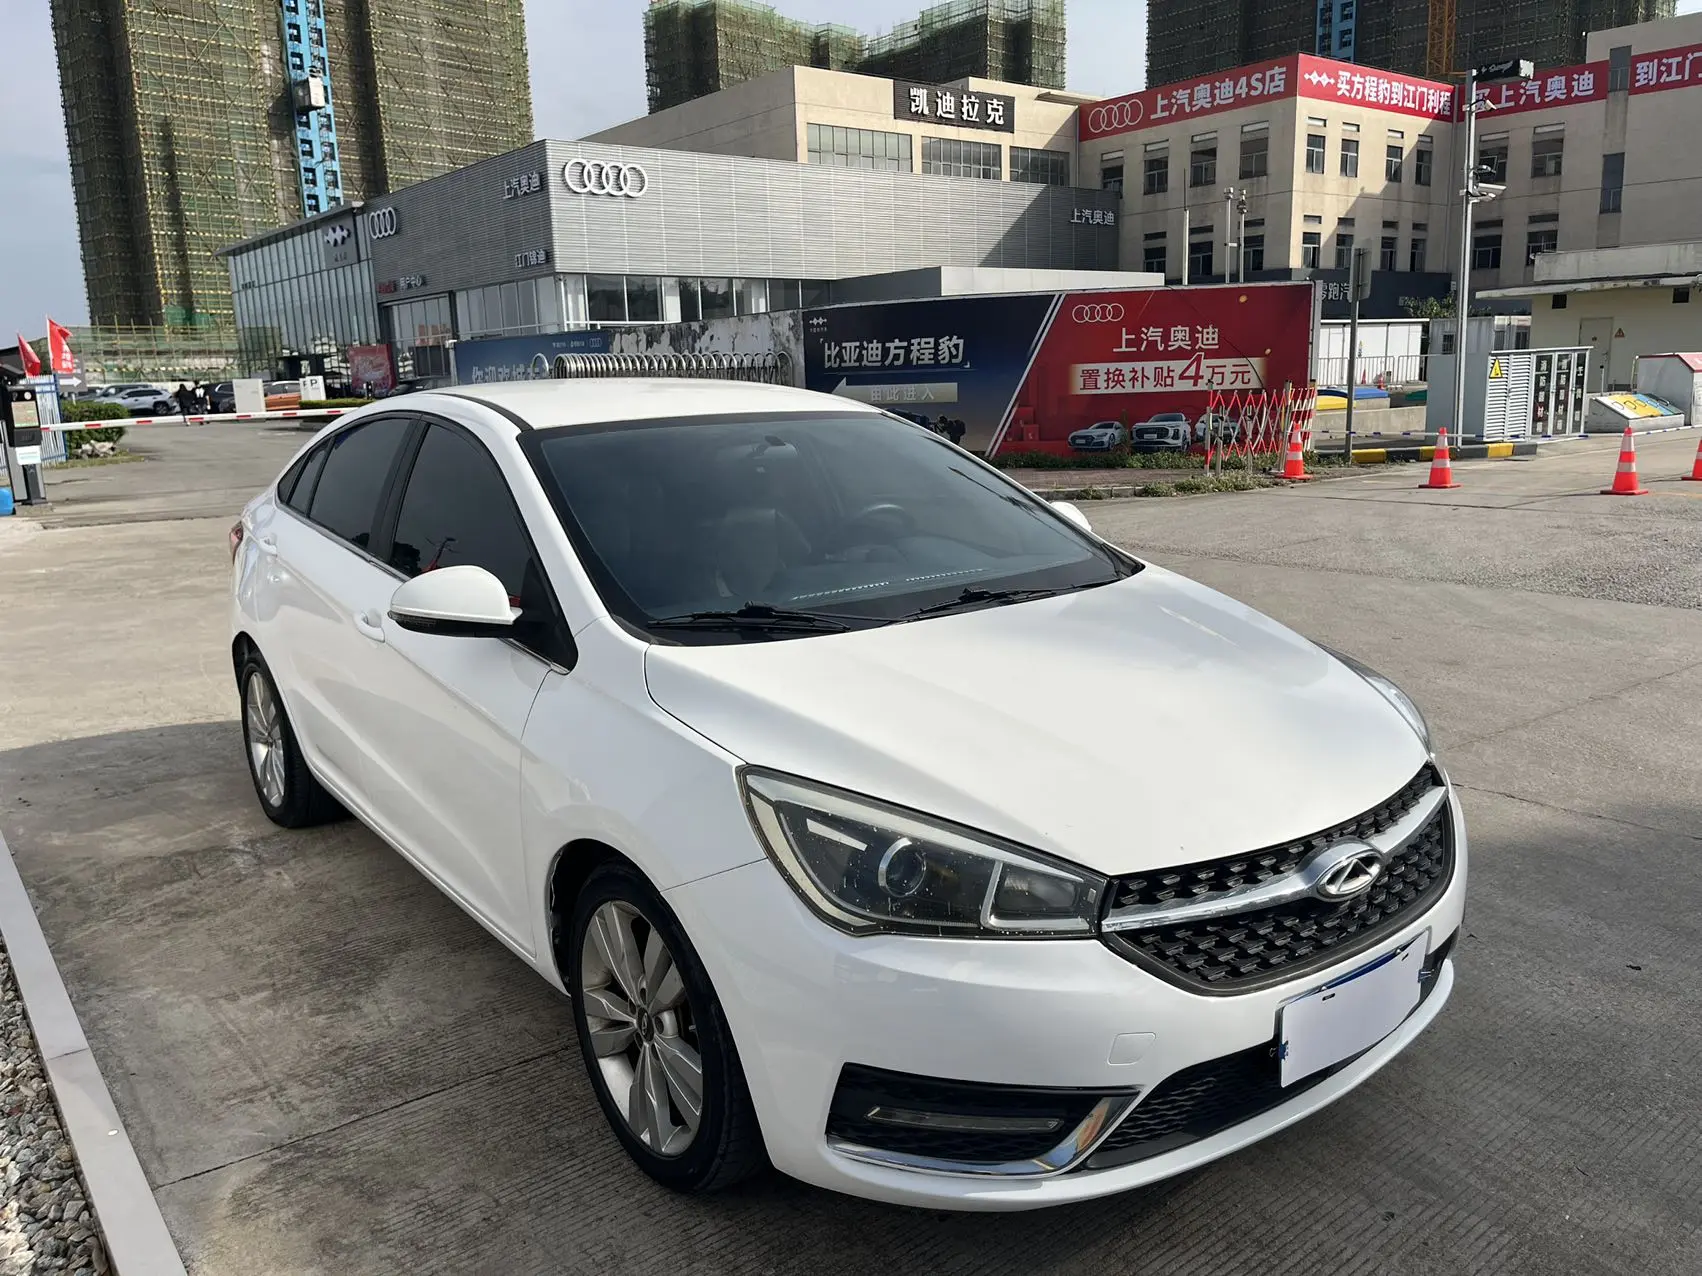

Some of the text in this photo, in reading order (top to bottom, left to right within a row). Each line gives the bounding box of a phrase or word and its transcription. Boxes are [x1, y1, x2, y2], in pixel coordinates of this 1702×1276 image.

[909, 87, 1005, 125] 凯迪拉克
[1150, 66, 1287, 119] 上汽奥迪4S店
[1336, 69, 1451, 115] 买方程豹到江门利程
[502, 171, 541, 200] 上汽奥迪
[1070, 208, 1116, 227] 上汽奥迪
[1112, 323, 1220, 352] 上汽奥迪
[310, 379, 318, 387] P
[1079, 352, 1252, 391] 置换补贴4万元
